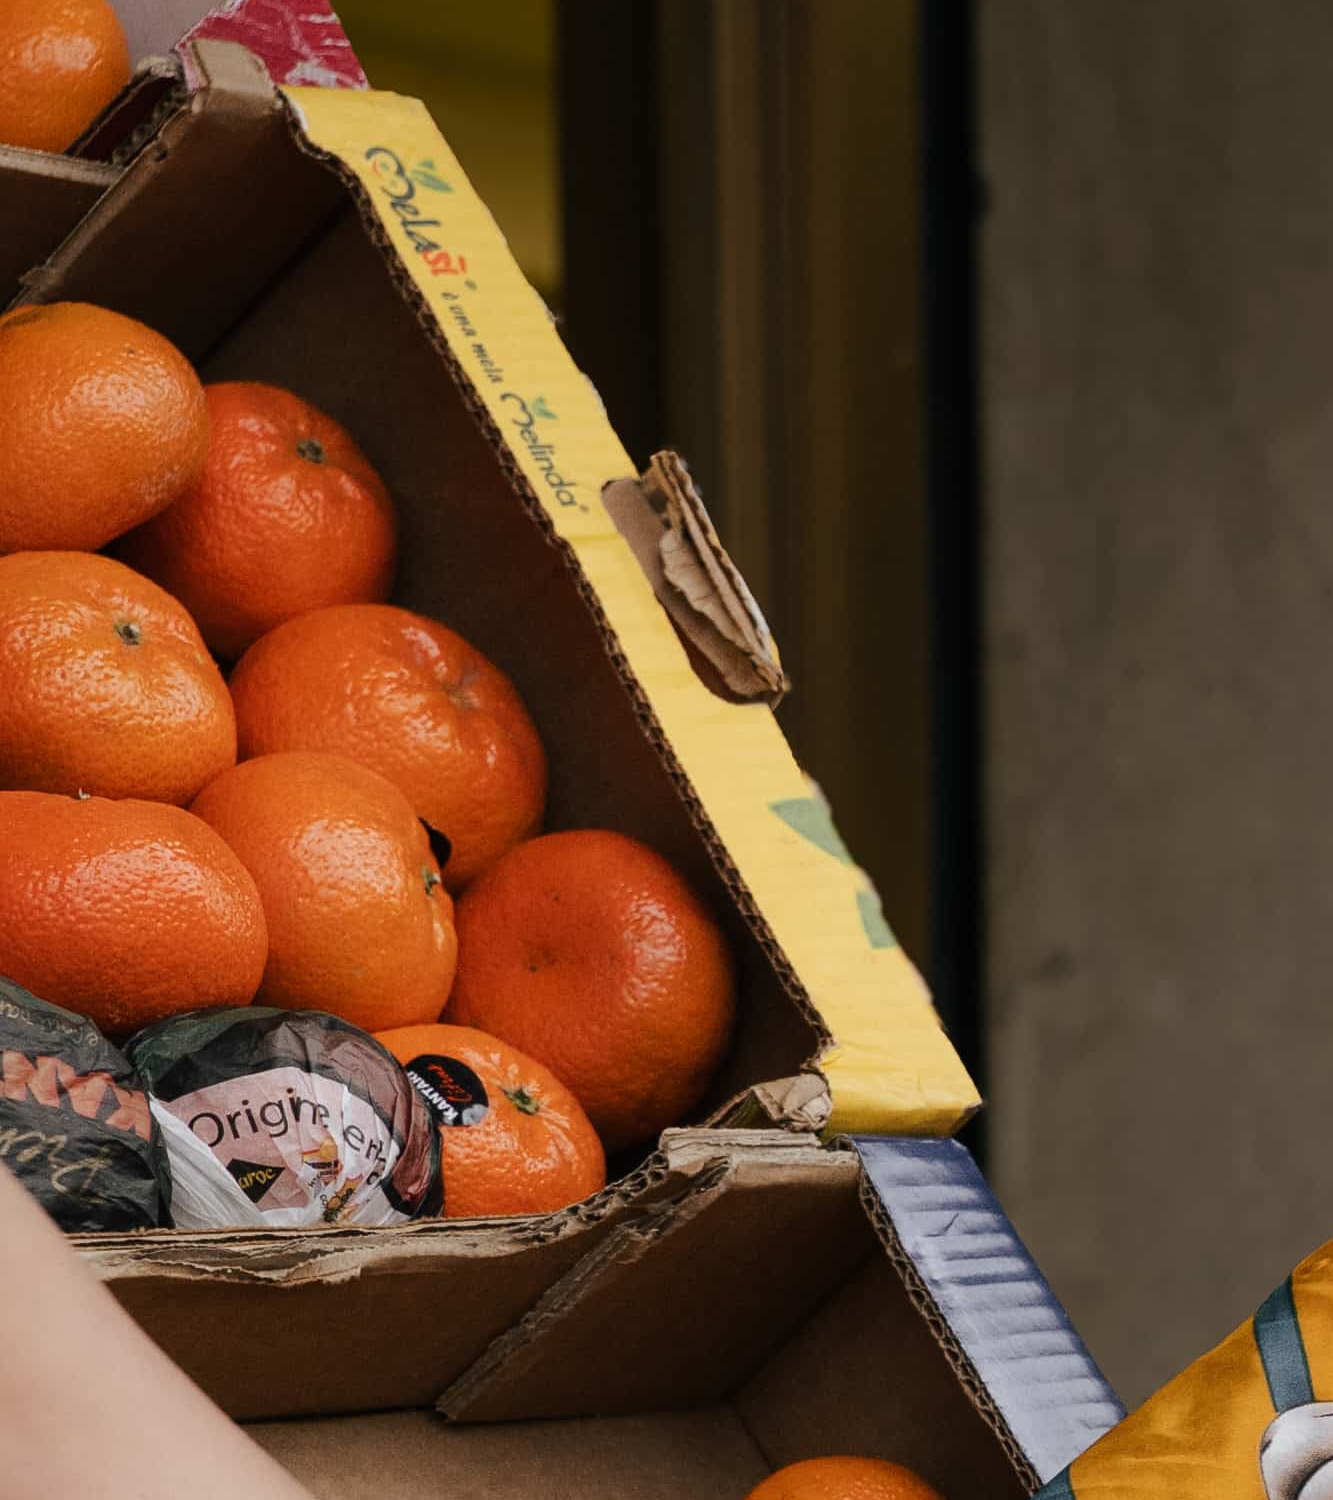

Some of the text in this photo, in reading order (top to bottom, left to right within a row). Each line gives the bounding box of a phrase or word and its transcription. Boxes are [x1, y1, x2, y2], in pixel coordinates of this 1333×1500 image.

[471, 342, 504, 385] mela
[500, 392, 578, 507] Melinda
[238, 1167, 278, 1189] aroc
